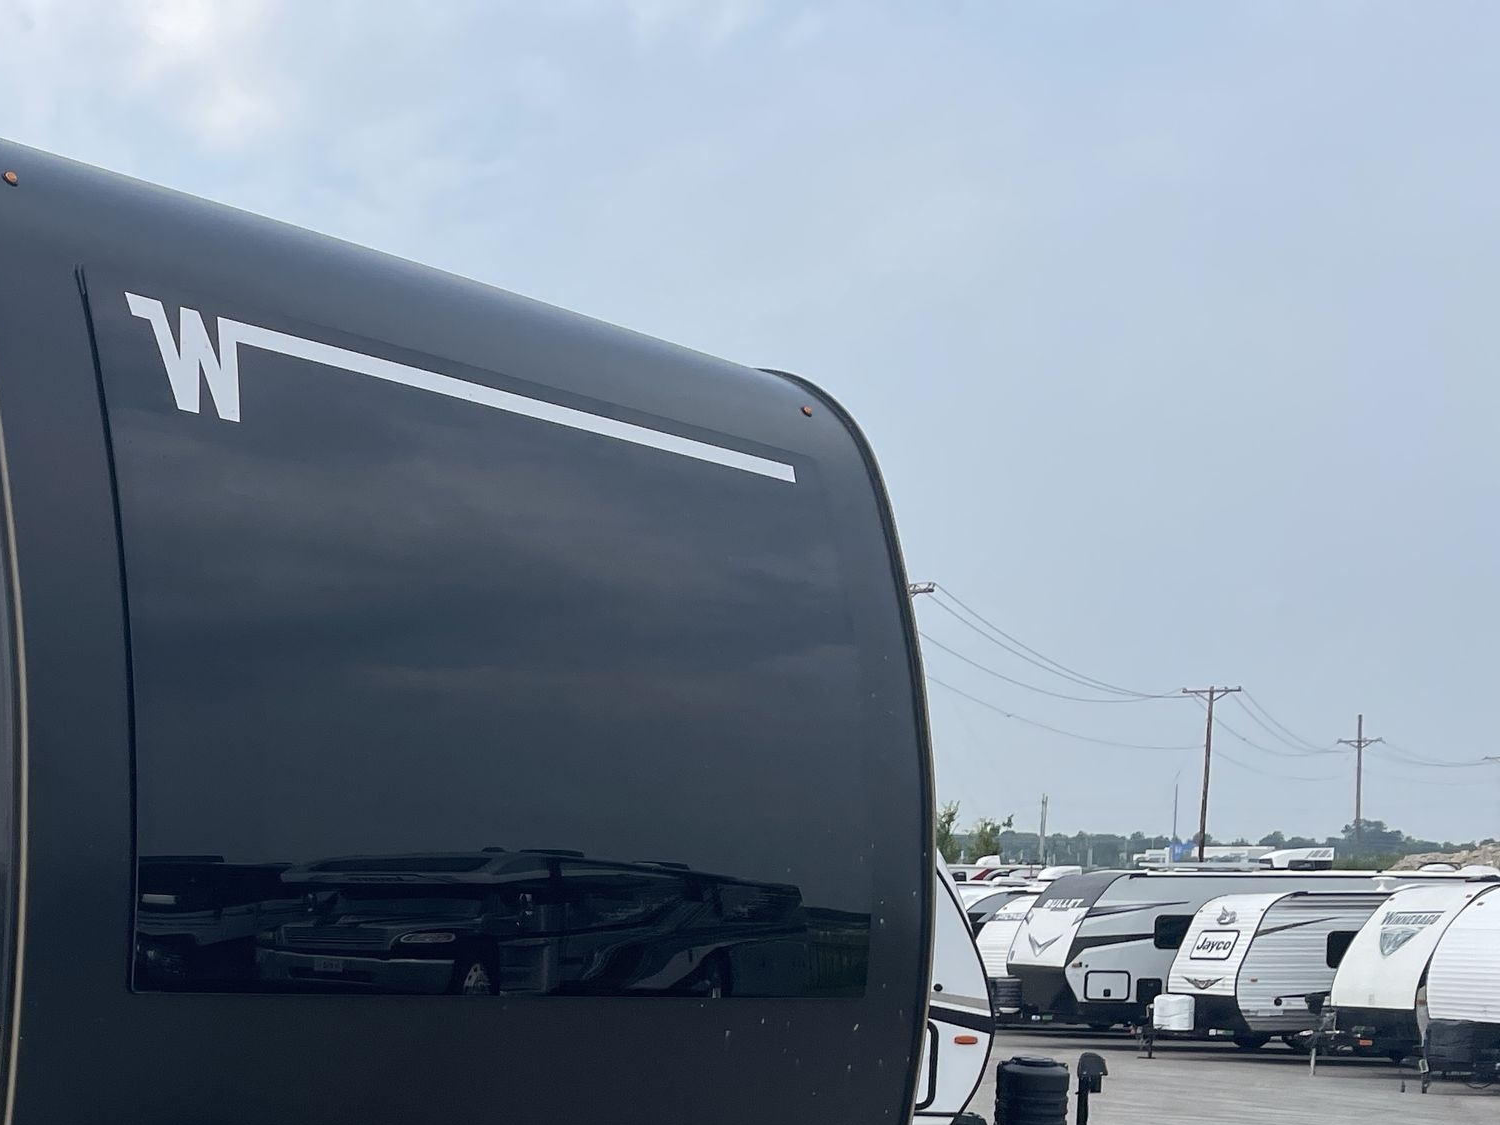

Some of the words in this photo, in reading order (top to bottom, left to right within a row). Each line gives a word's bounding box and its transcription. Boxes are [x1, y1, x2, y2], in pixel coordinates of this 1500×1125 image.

[1043, 898, 1085, 908] BULLET
[1381, 910, 1446, 925] WINNEBAGO
[1196, 937, 1232, 953] Jayco
